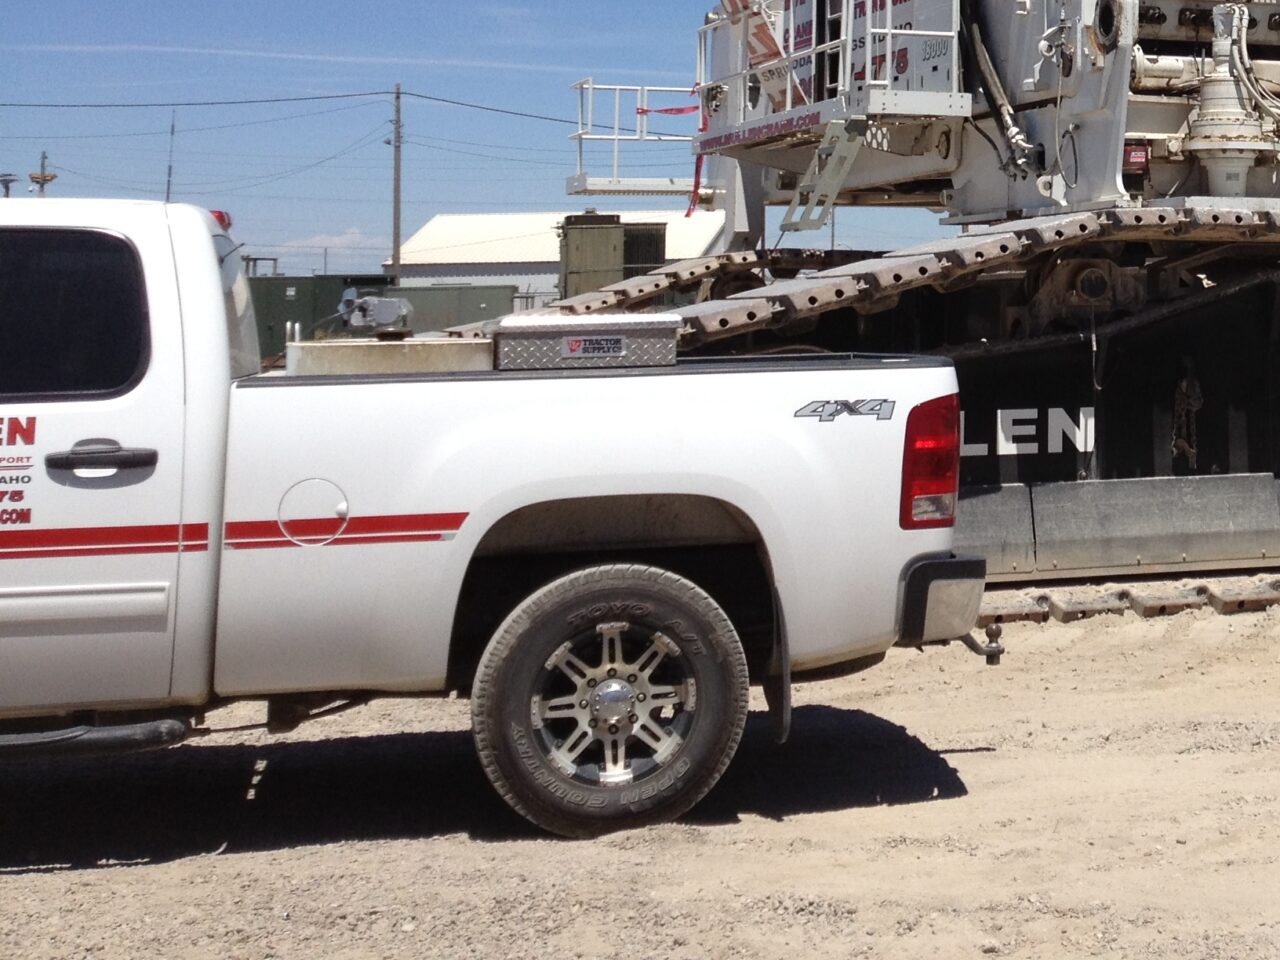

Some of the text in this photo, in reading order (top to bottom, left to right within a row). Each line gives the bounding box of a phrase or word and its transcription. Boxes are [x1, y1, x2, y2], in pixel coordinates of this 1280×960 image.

[582, 338, 622, 346] TRACTOR
[582, 346, 611, 354] SUPPLY
[0, 416, 37, 446] N
[567, 602, 654, 626] TOYO
